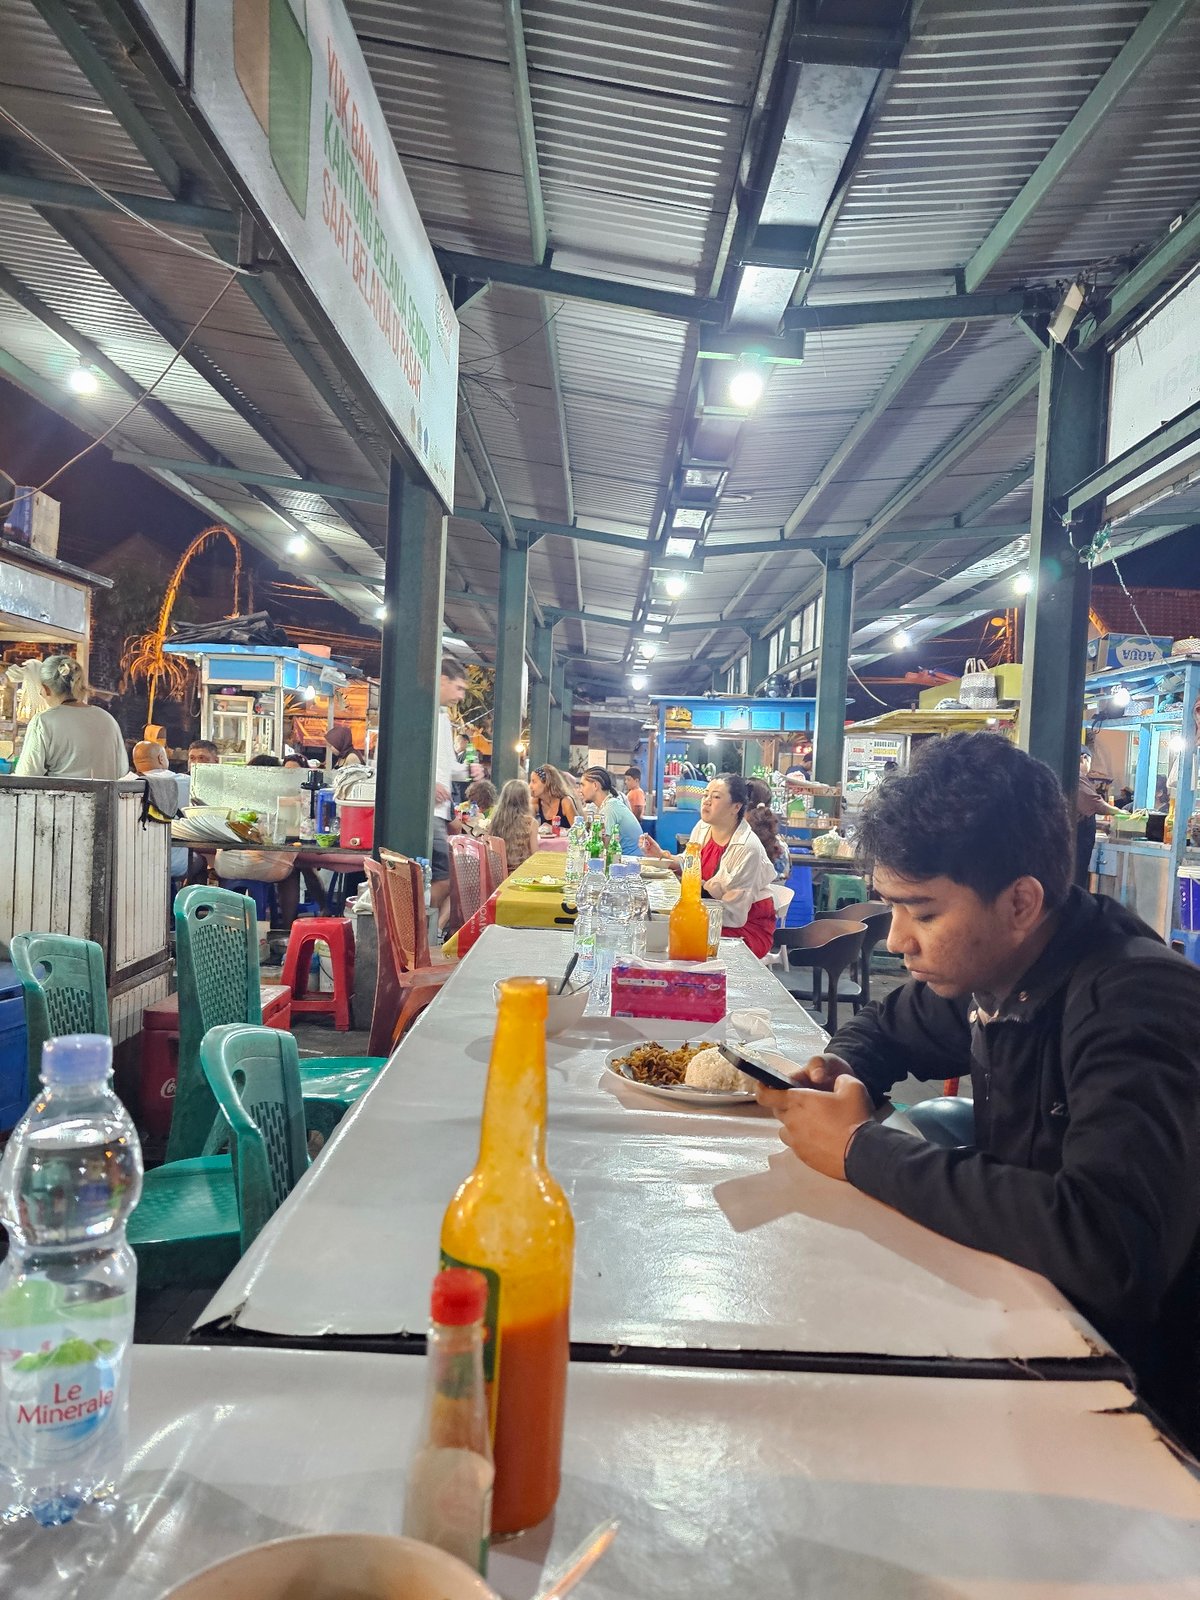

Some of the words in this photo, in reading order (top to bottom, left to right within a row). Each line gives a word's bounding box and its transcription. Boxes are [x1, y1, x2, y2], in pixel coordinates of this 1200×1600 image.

[327, 36, 350, 138] YUK
[351, 101, 379, 211] BAWA
[324, 101, 373, 250] KANTONG
[373, 215, 407, 326] BELANJA
[322, 168, 352, 265] SAAT
[352, 231, 391, 346] BELANJA
[399, 328, 421, 403] PASAR
[1122, 648, 1156, 662] AQUA
[17, 1389, 114, 1424] Minerale
[53, 1383, 82, 1405] Le
